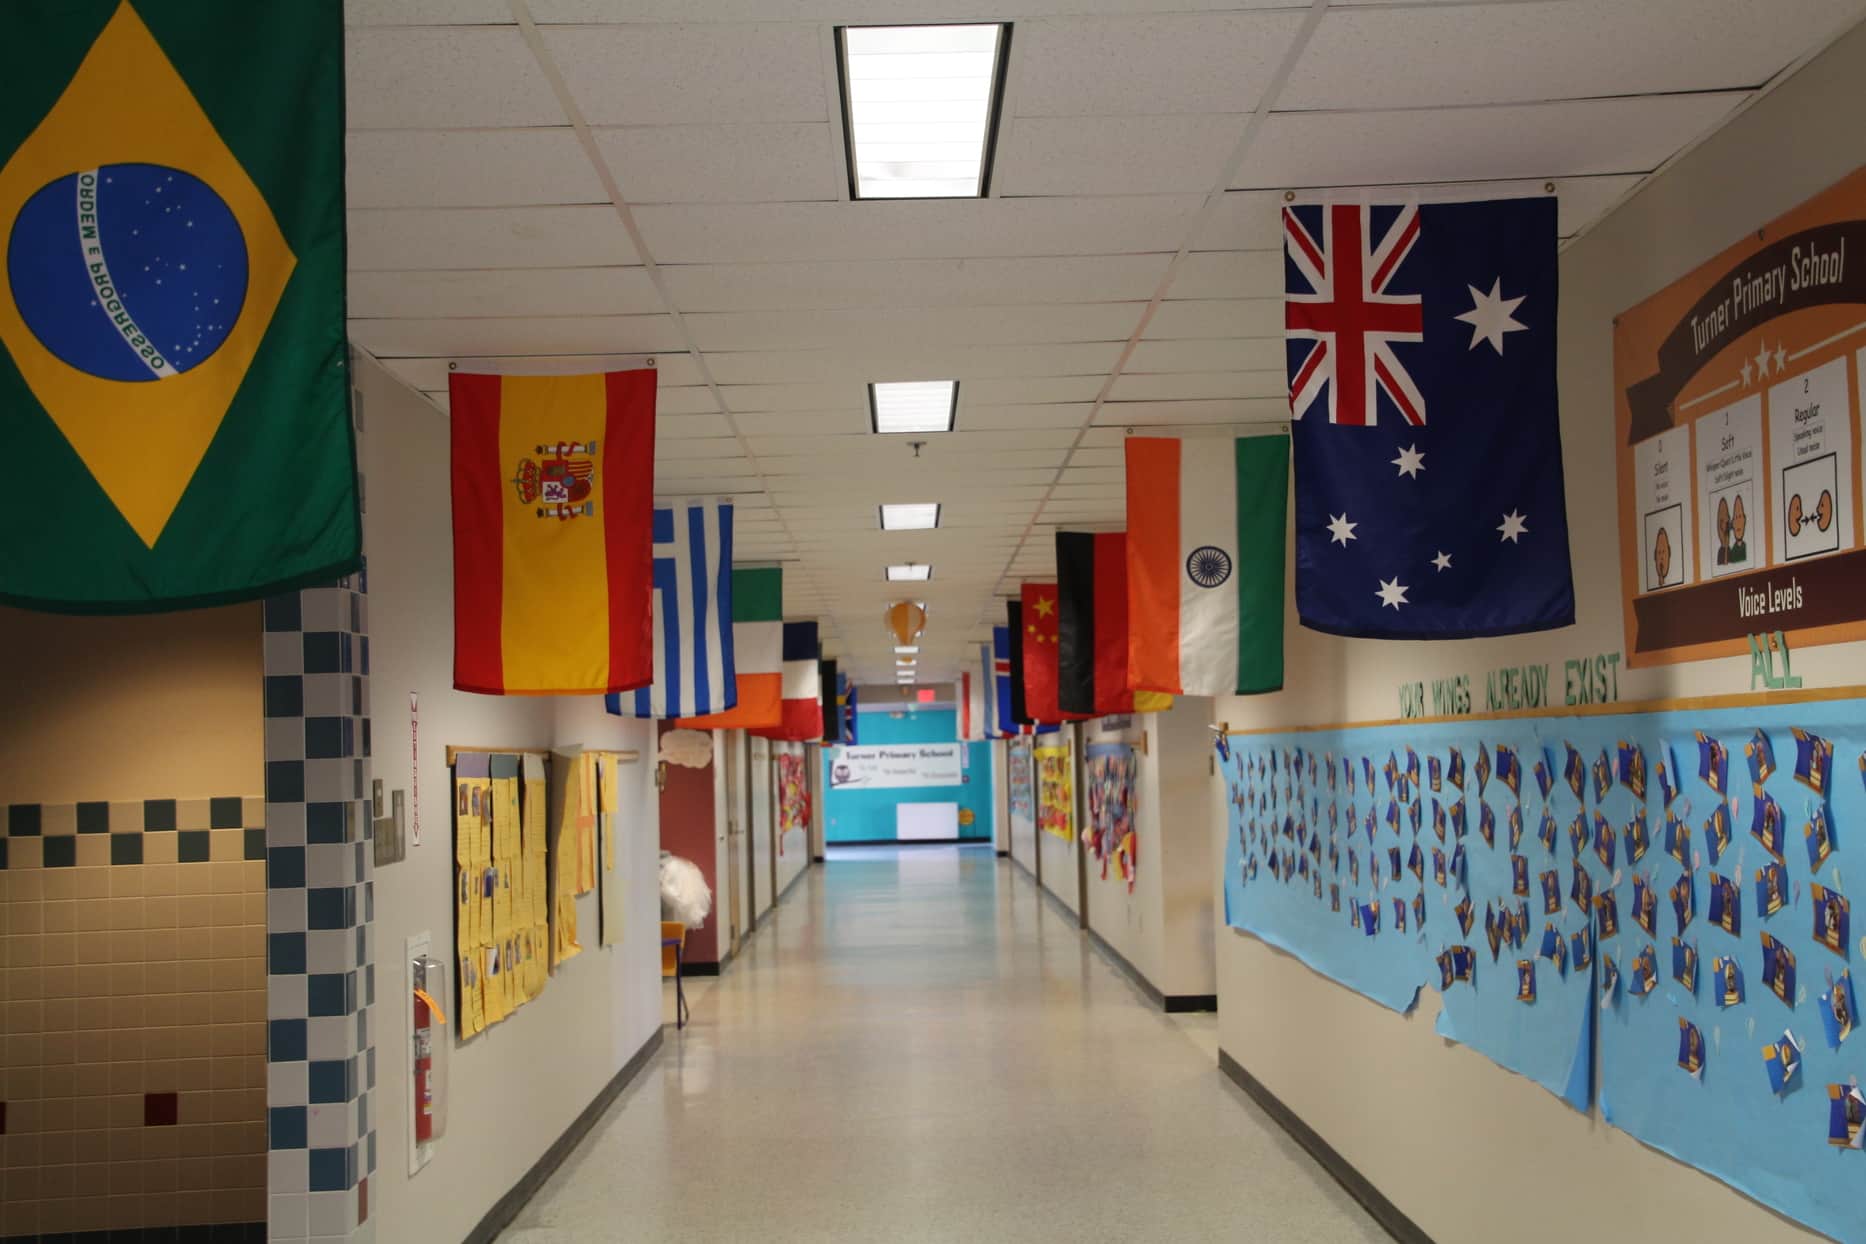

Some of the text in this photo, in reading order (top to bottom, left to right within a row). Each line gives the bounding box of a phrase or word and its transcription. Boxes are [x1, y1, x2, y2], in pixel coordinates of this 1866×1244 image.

[1691, 236, 1845, 356] Turner Primary School
[1803, 378, 1809, 394] 2
[1794, 402, 1820, 426] Regular
[1721, 434, 1735, 451] Soft
[1738, 576, 1804, 618] Voice Levels
[1399, 630, 1804, 718] YOUR WINGS ALREADY EXIST ALL
[919, 748, 954, 758] School
